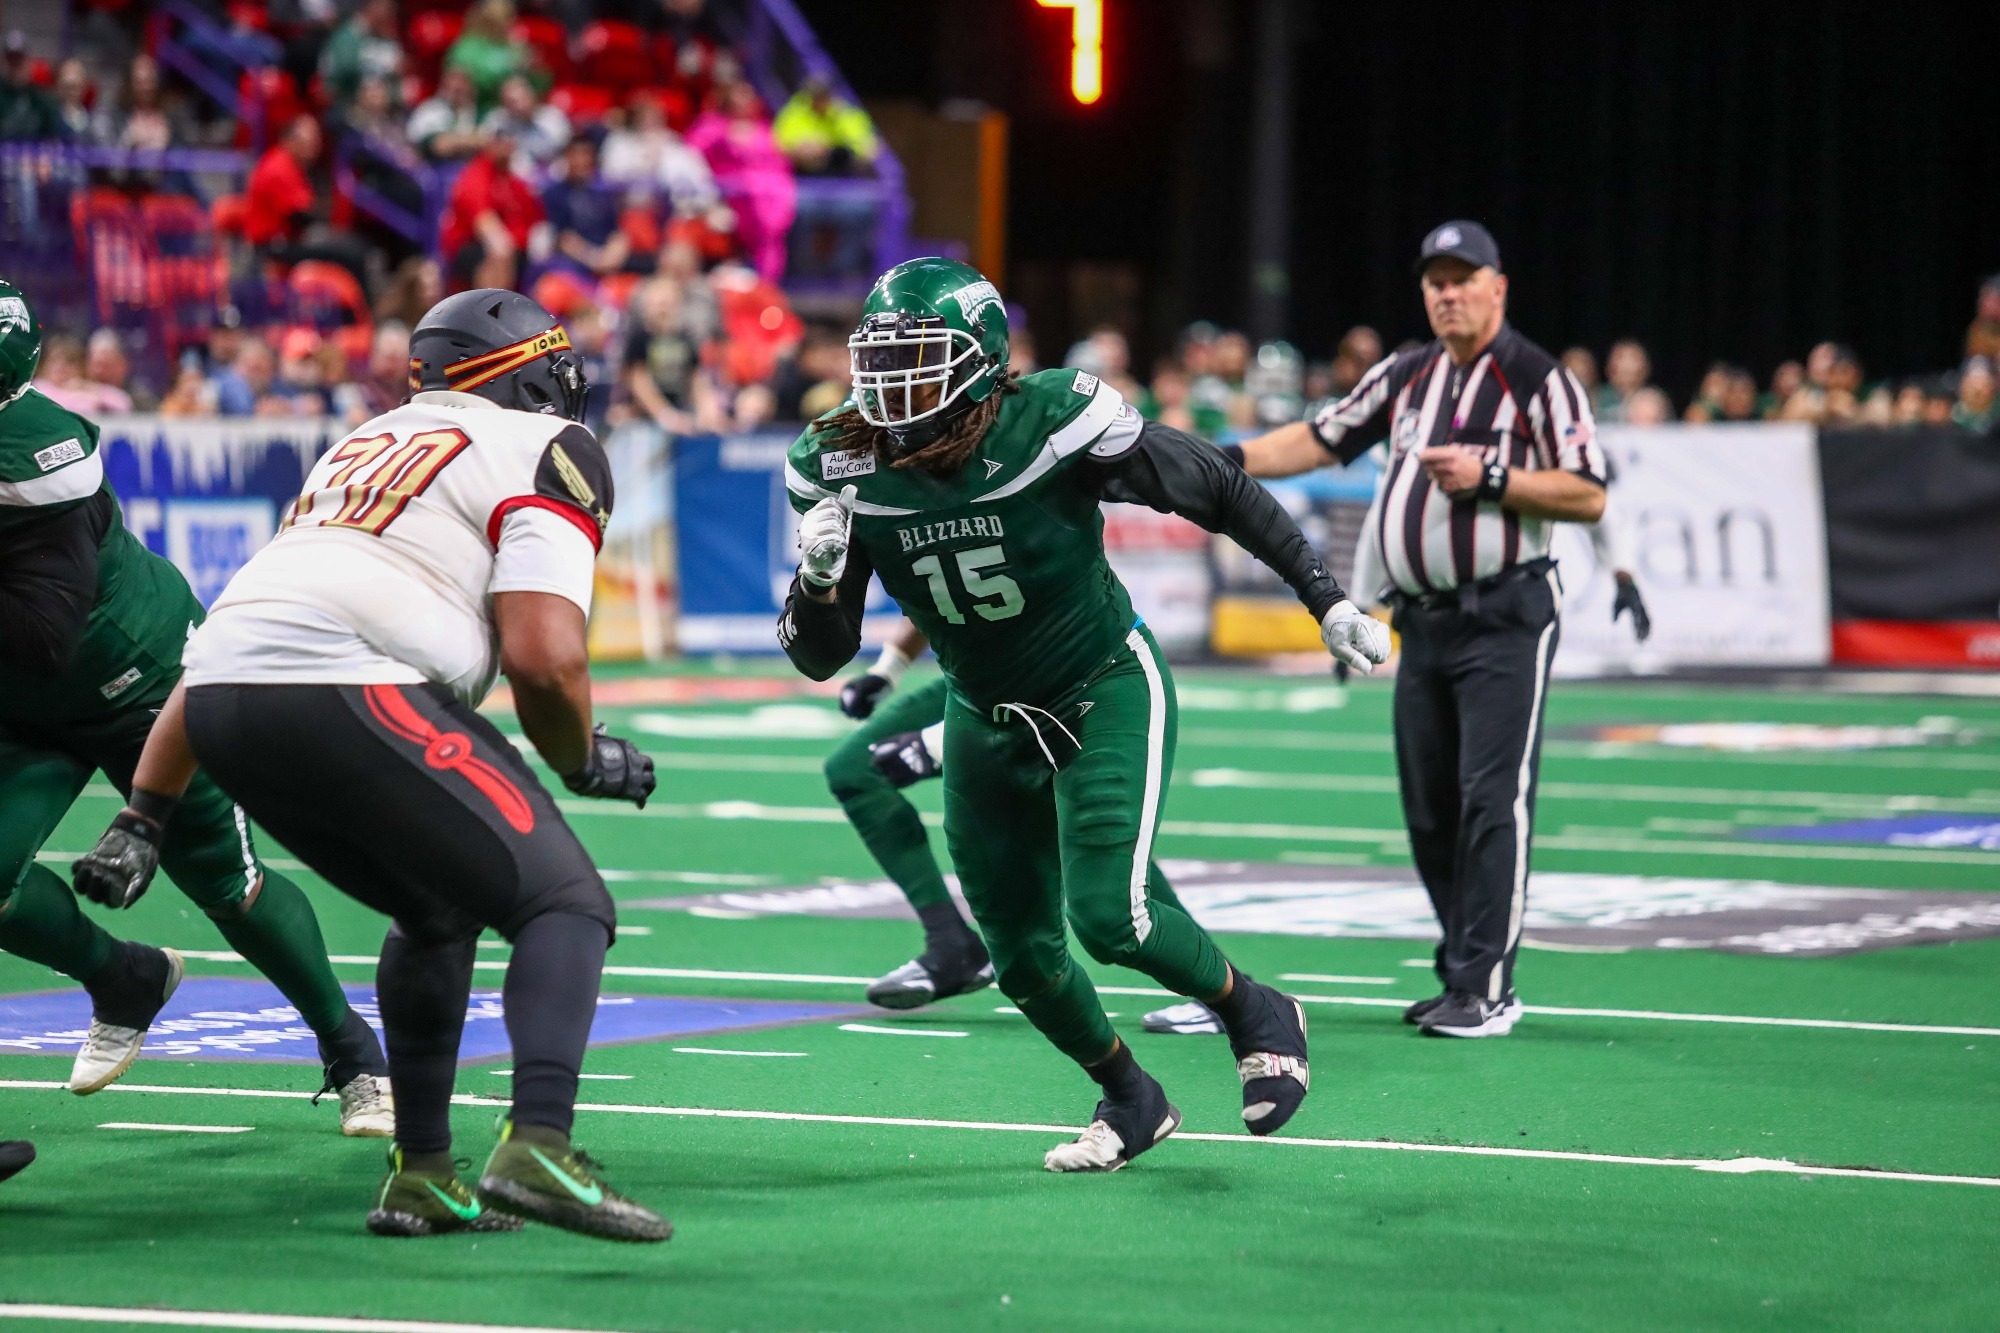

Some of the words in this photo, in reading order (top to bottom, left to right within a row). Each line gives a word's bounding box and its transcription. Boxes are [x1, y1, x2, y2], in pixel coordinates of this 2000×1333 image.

[533, 332, 564, 354] IOWA
[826, 461, 872, 477] BayCare
[829, 449, 867, 464] Aura
[280, 428, 472, 538] 70
[897, 515, 1004, 552] BLIZZARD
[911, 545, 1025, 625] 15
